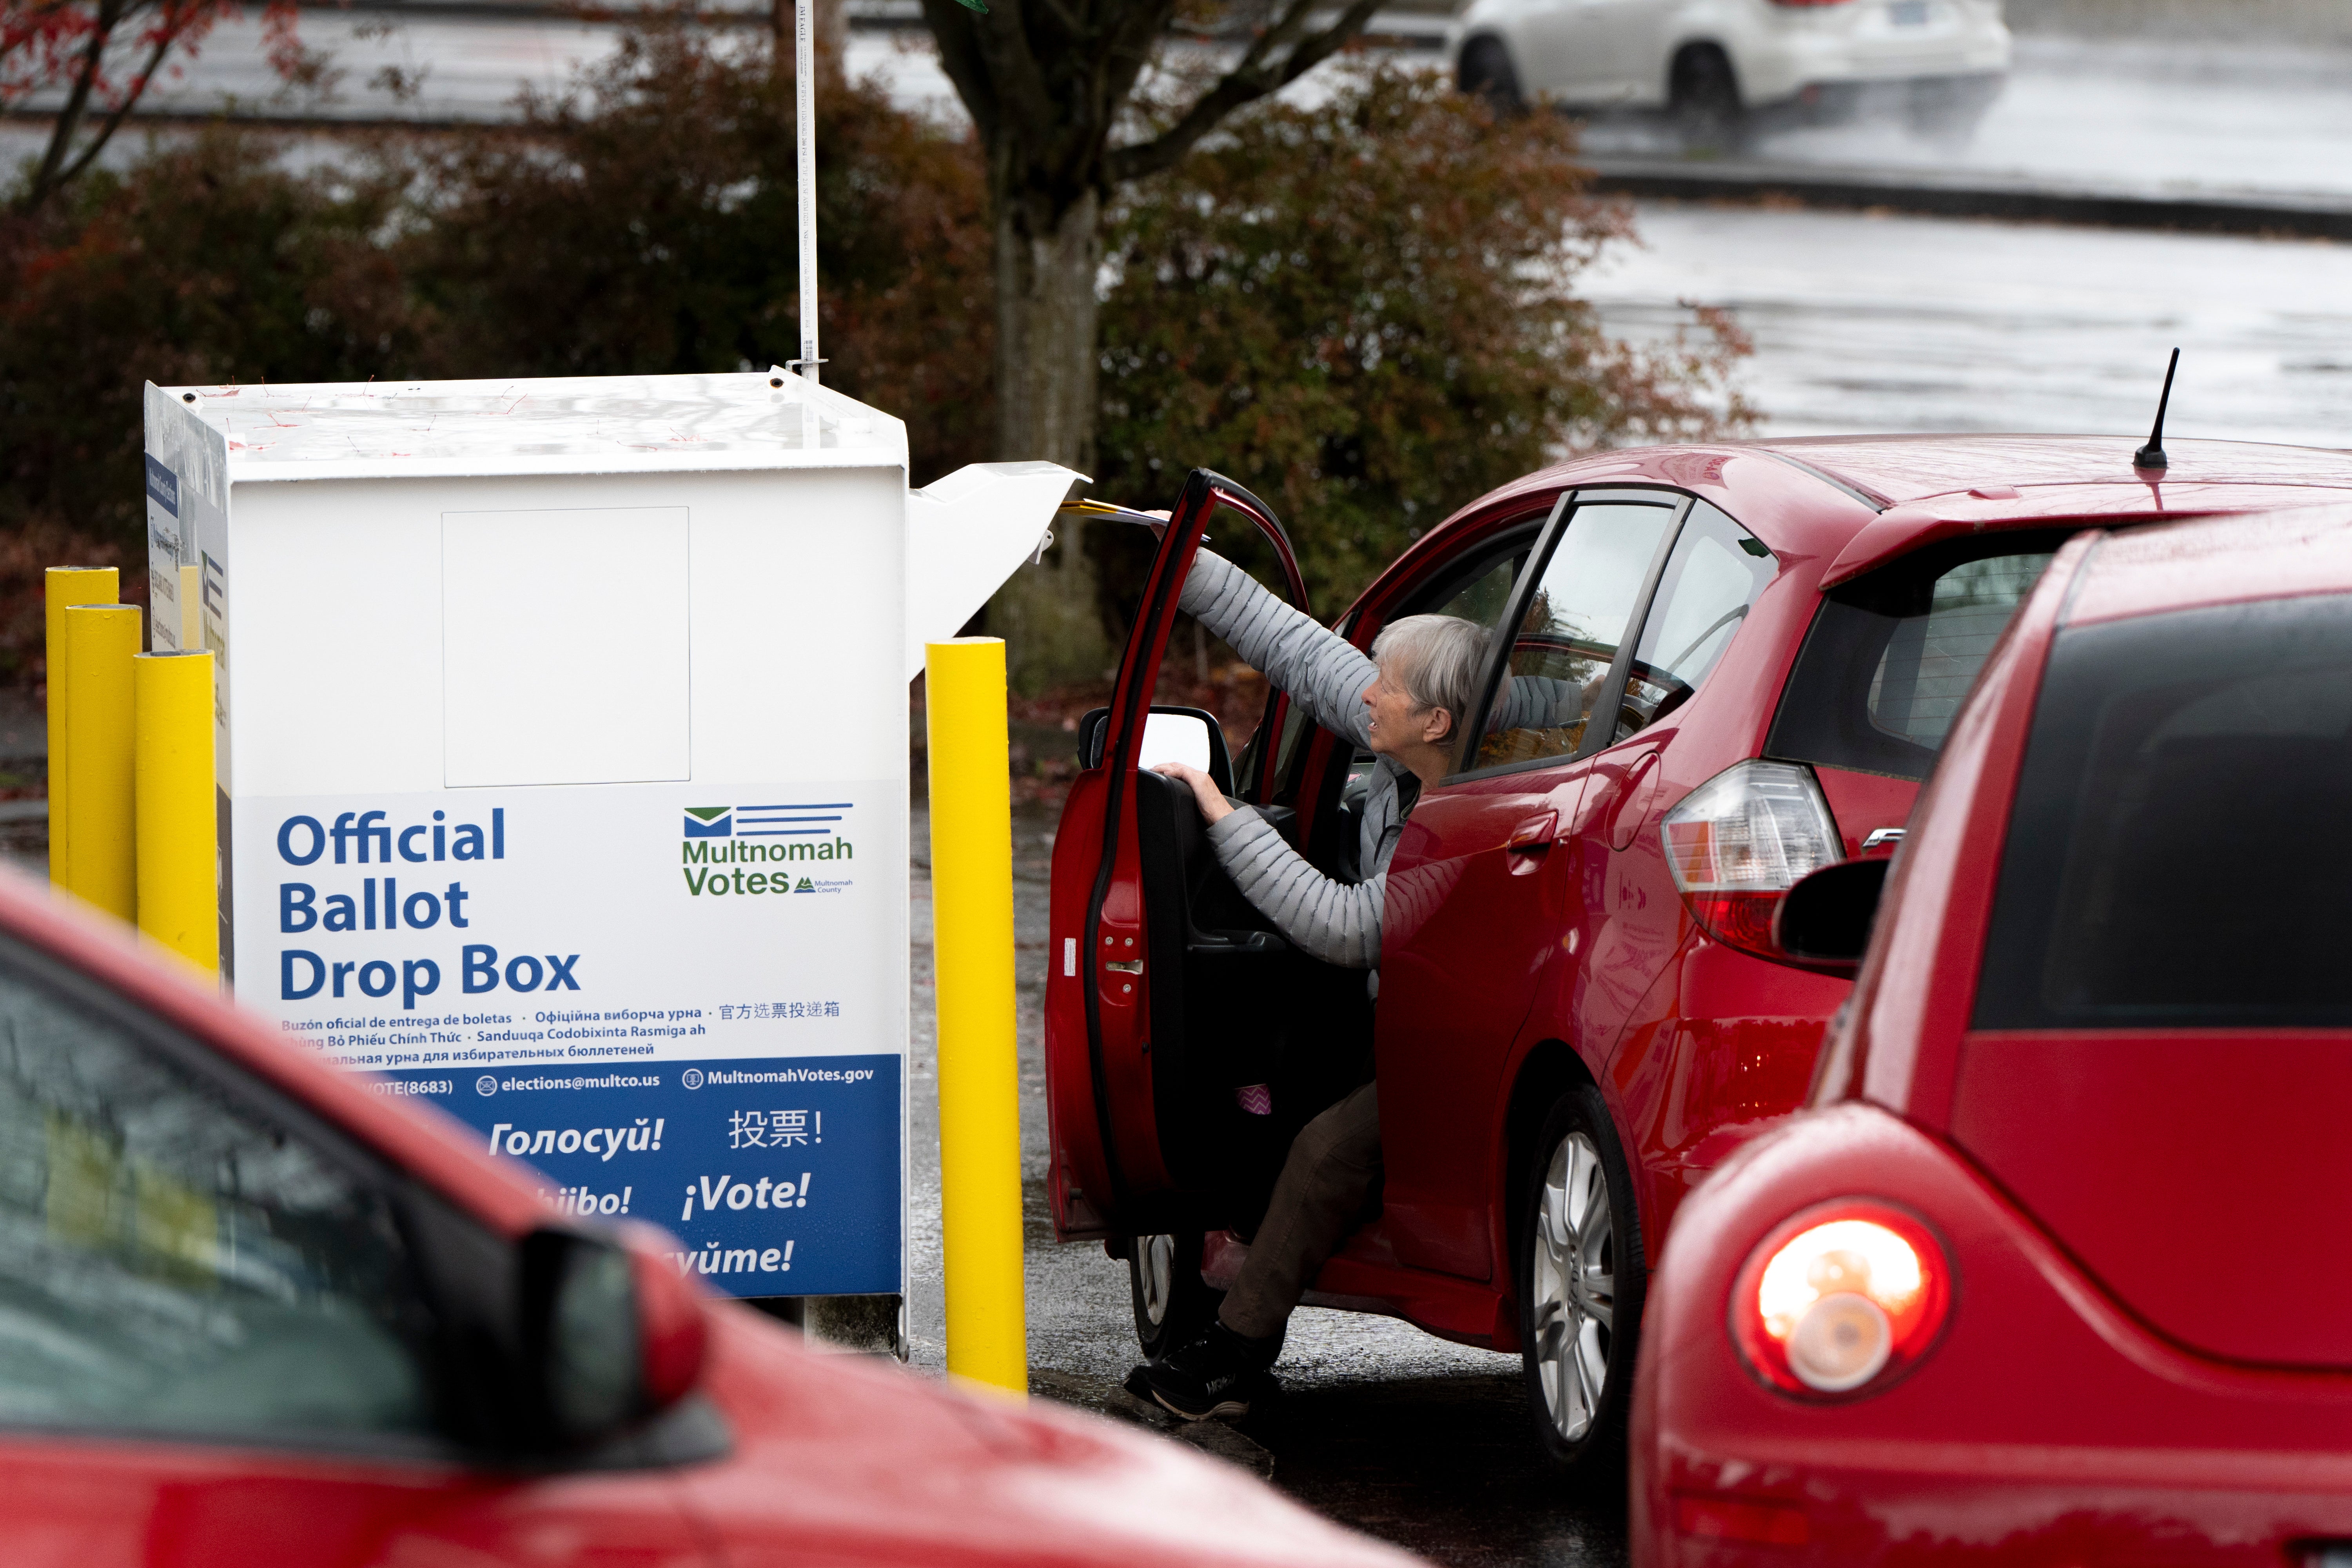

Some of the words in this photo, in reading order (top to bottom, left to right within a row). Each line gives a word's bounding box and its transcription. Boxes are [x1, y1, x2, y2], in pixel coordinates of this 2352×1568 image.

[799, 5, 806, 16] JM
[277, 808, 504, 866] Official
[683, 837, 853, 864] Multnomah
[683, 867, 789, 896] Votes
[280, 878, 468, 933] Ballot
[281, 950, 440, 1009] Drop
[463, 944, 581, 994] Box
[282, 1019, 323, 1031] Buzón
[327, 1017, 365, 1029] oficial
[370, 1017, 385, 1027] de
[389, 1017, 439, 1029] entrega
[444, 1014, 459, 1025] de
[463, 1013, 512, 1024] boletas
[535, 1011, 600, 1024] Офіційна
[604, 1009, 664, 1021] виборча
[668, 1010, 701, 1021] урна
[719, 1001, 839, 1020] 官方选票投递箱
[283, 1036, 325, 1051] hùng
[328, 1035, 345, 1046] Bỏ
[349, 1033, 385, 1045] Phiếu
[389, 1033, 426, 1044] Chính
[430, 1032, 461, 1042] Thức
[477, 1030, 543, 1042] Sanduuqa
[548, 1027, 627, 1039] Codobixinta
[631, 1025, 686, 1038] Rasmiga
[690, 1024, 705, 1034] ah
[386, 1054, 419, 1065] урна
[423, 1053, 448, 1063] для
[453, 1049, 564, 1062] избирательных
[568, 1044, 653, 1056] бюллетеней
[502, 1074, 660, 1091] elections@multco.us
[708, 1069, 873, 1084] MultnomahVotes.gov
[489, 1118, 664, 1162] Голосуй!
[537, 1186, 633, 1216] hiibo!
[682, 1172, 811, 1220] ¡Vote!
